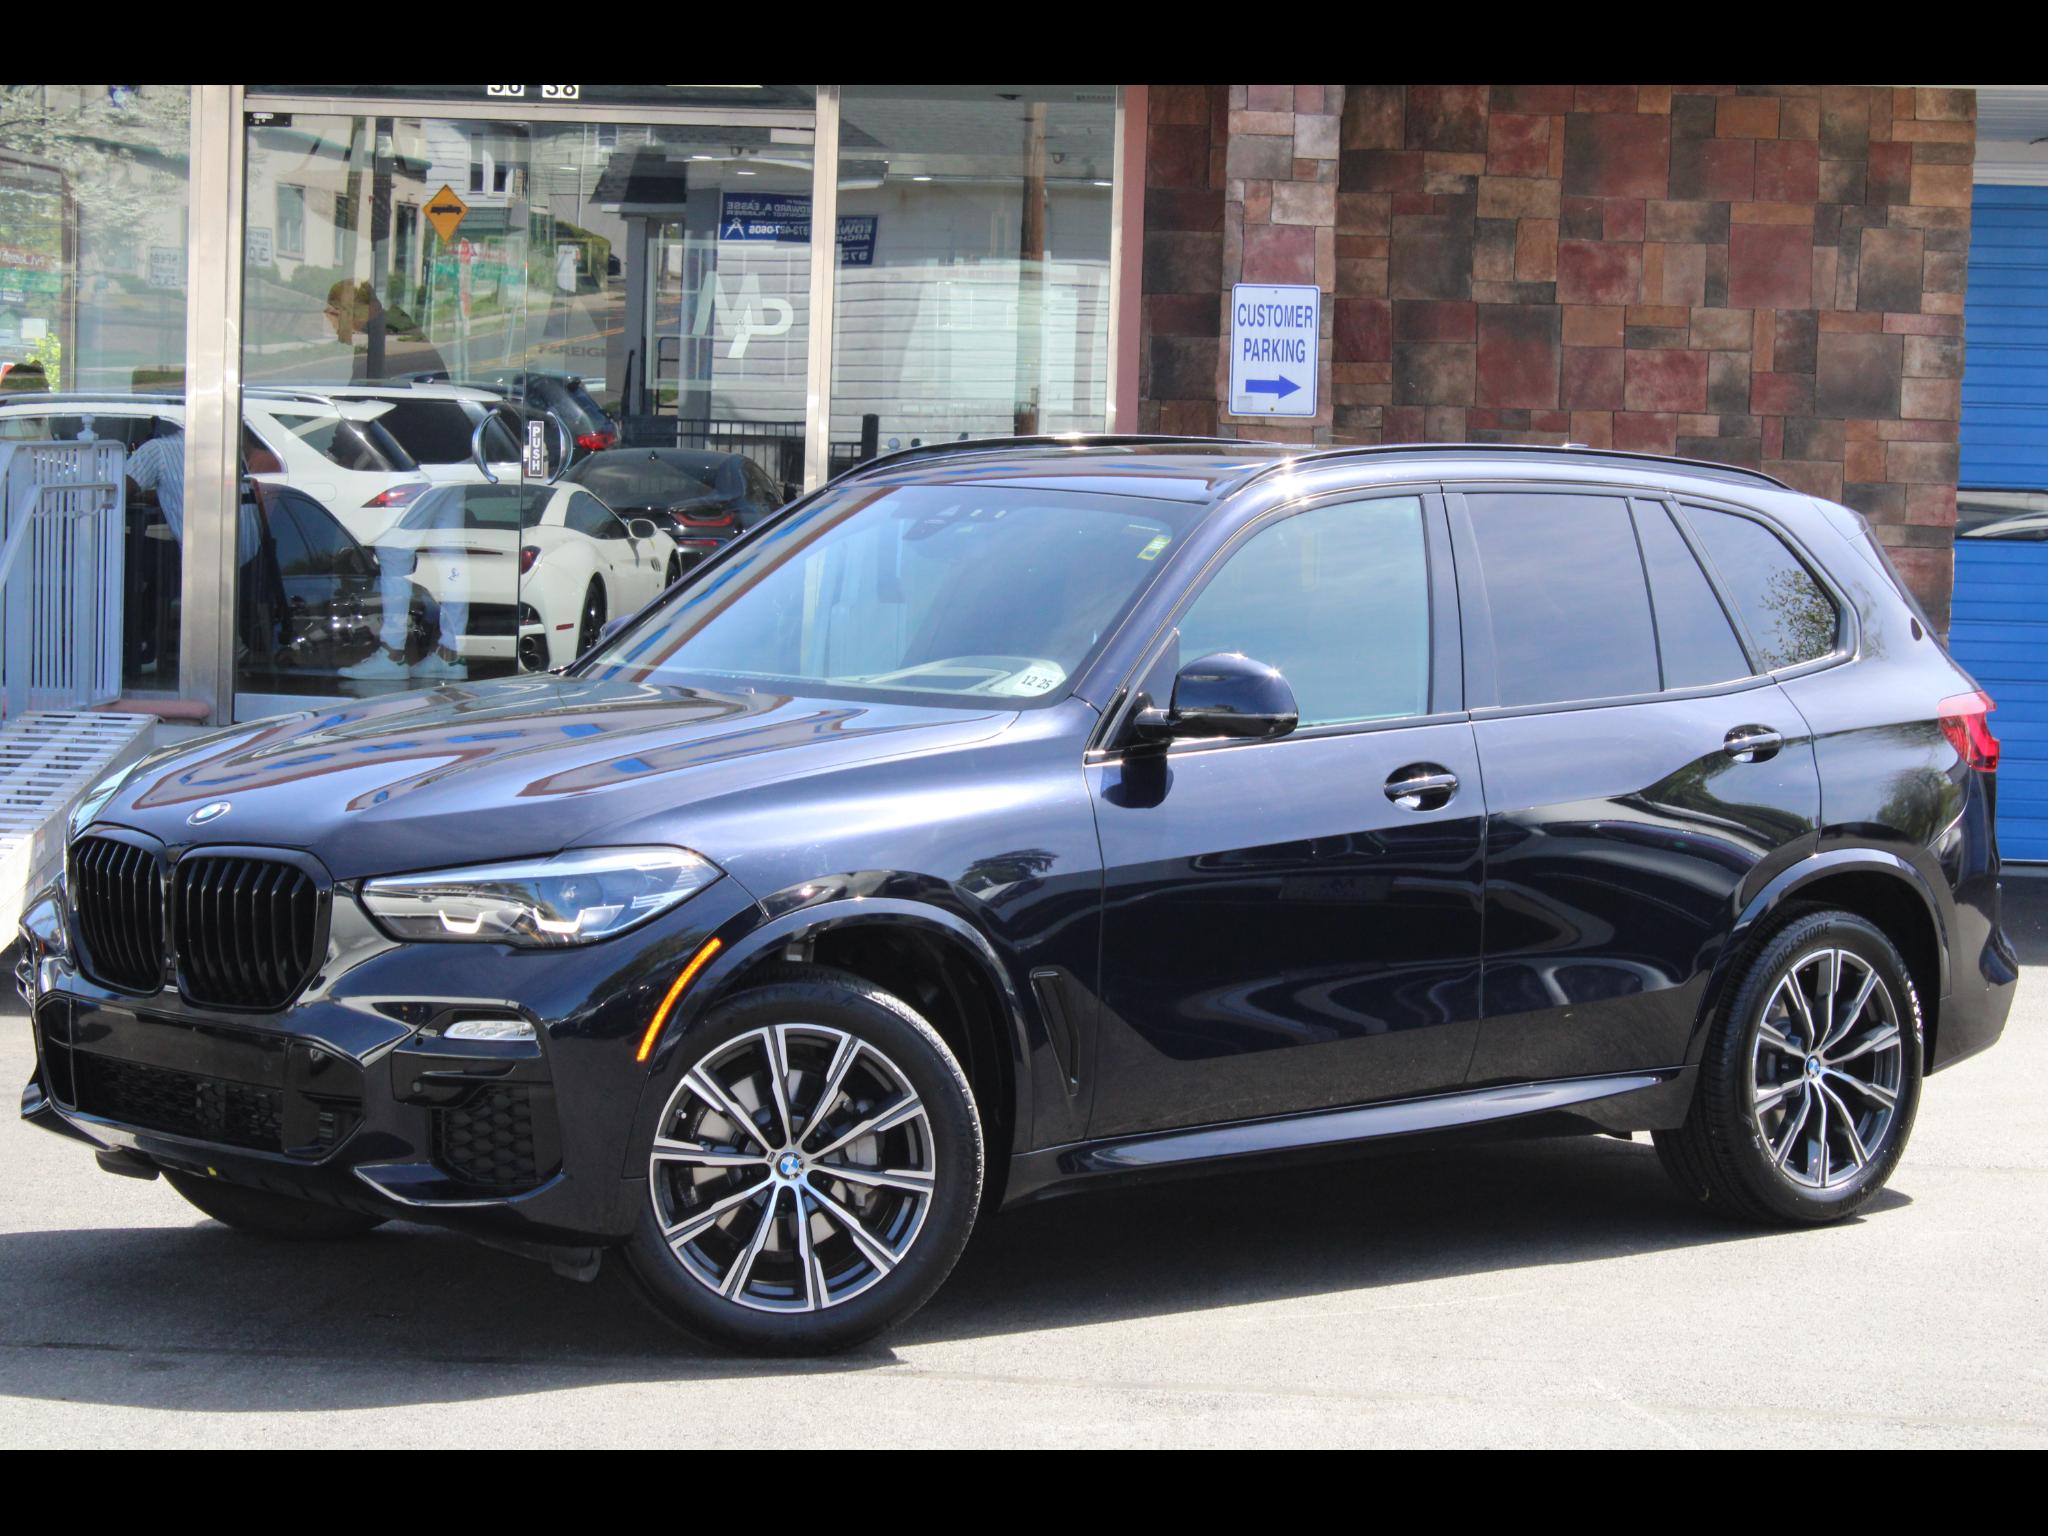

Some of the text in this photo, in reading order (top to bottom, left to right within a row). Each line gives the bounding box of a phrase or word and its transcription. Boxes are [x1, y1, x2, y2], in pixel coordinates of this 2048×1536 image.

[1238, 303, 1313, 328] CUSTOMER
[1243, 338, 1305, 363] PARKING
[532, 426, 541, 471] PUSH
